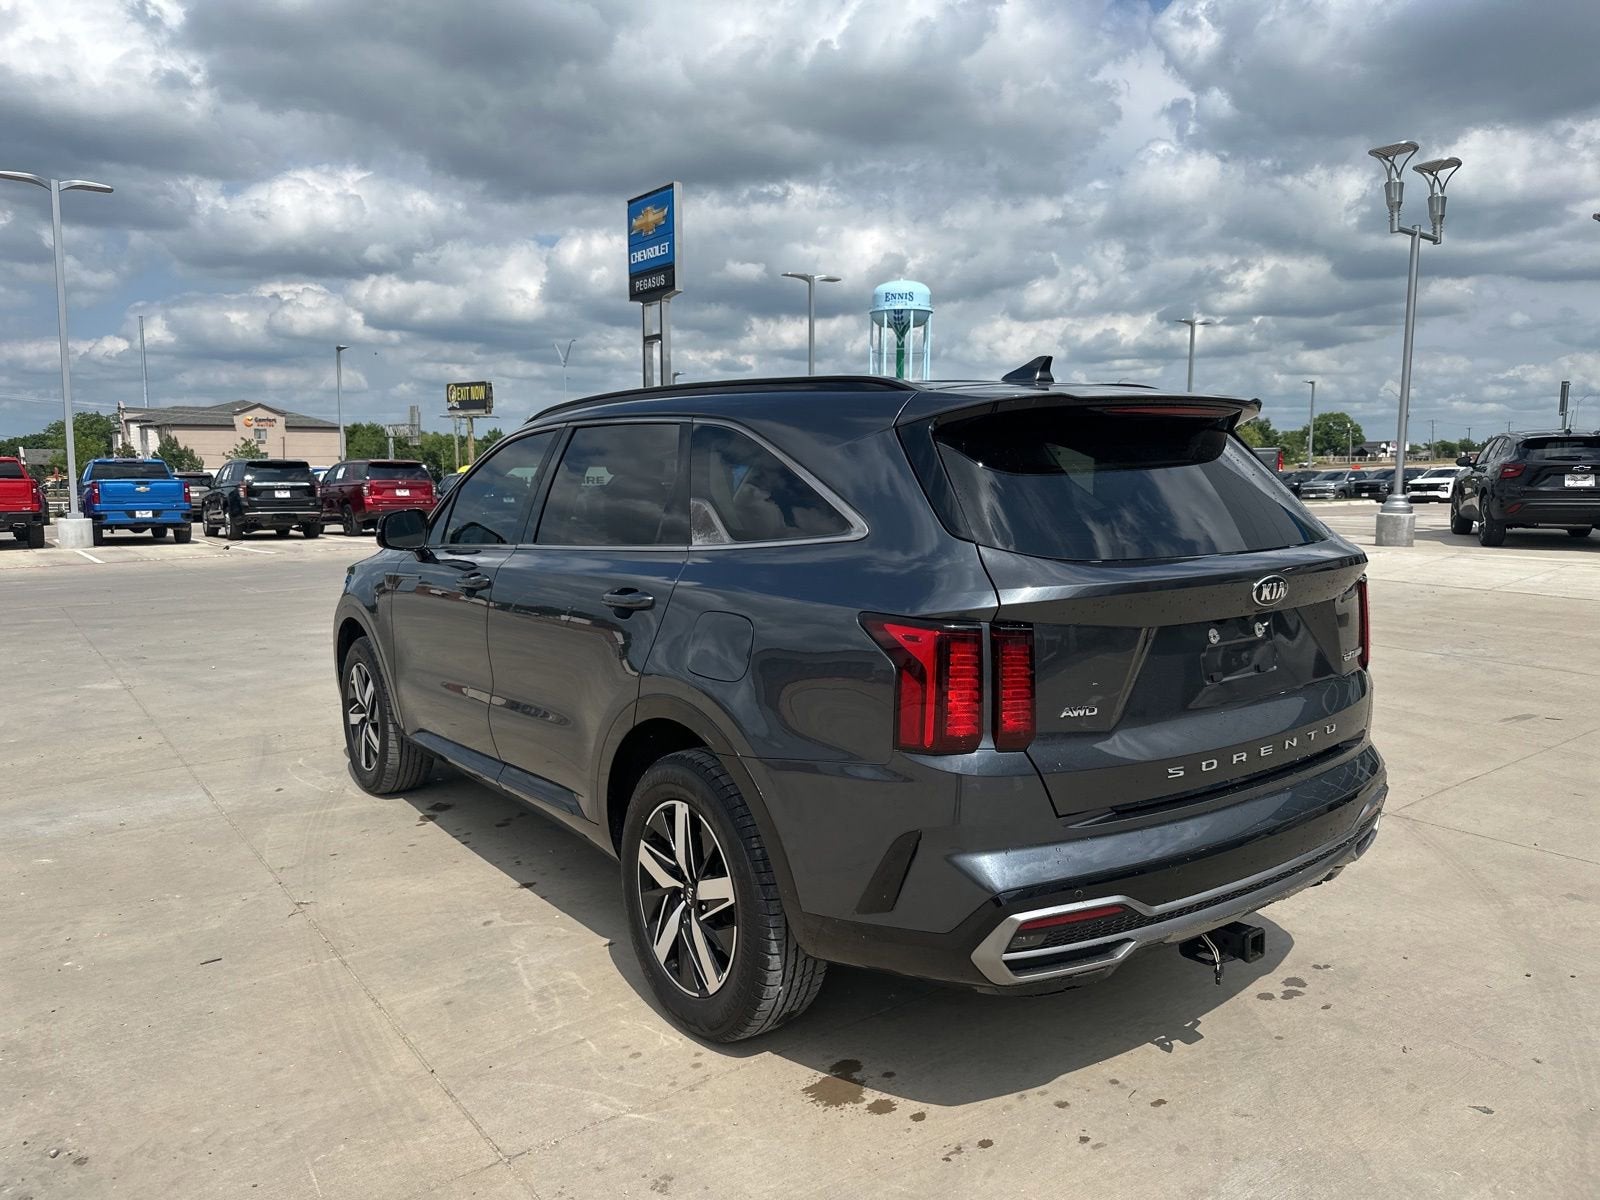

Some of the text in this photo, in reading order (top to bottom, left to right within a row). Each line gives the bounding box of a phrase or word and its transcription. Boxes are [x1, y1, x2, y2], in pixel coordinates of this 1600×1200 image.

[631, 242, 670, 264] CHEVROLET
[635, 274, 665, 292] PEGASUS
[885, 291, 914, 302] ENNIS
[1261, 581, 1285, 601] KIA
[1060, 705, 1098, 718] AWD
[1167, 723, 1337, 779] SORENTO
